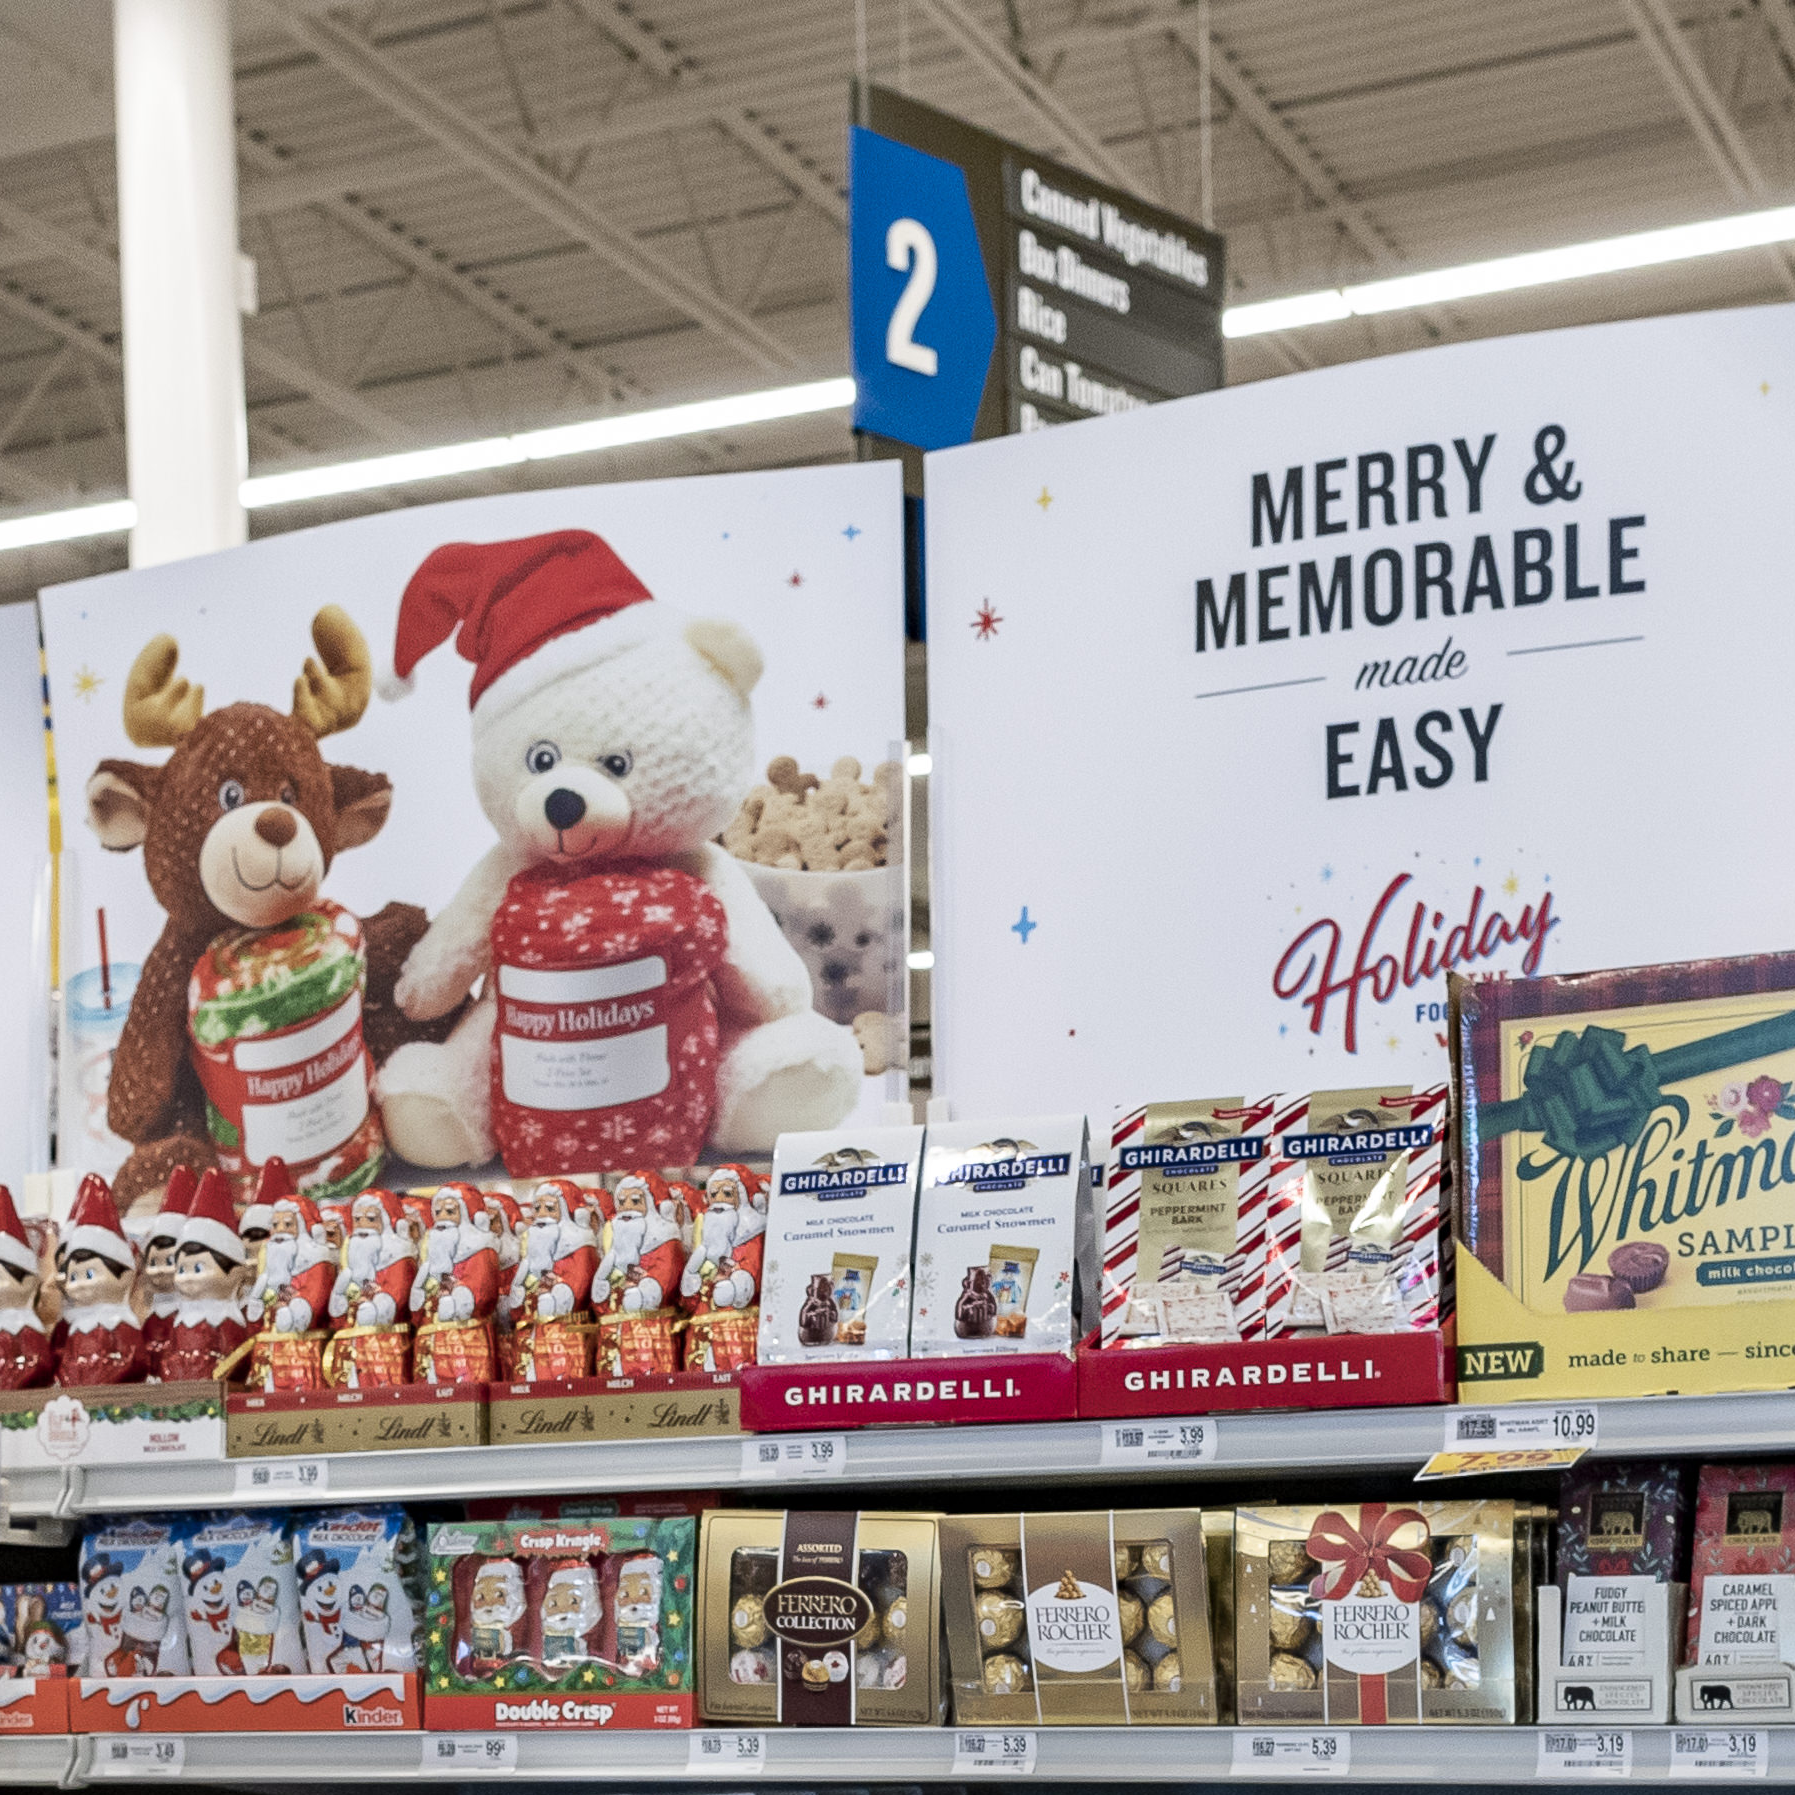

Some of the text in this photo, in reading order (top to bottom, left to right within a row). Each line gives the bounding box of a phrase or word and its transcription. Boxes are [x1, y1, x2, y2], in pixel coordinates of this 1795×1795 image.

[886, 218, 938, 377] 2
[1251, 424, 1582, 547] MERRY &
[1194, 515, 1646, 652] MEMORABLE
[1354, 637, 1469, 691] made
[1325, 703, 1504, 799] EASY
[1272, 873, 1559, 1053] Holiday
[506, 999, 655, 1037] Happy Holidays
[1124, 1138, 1260, 1167] GHIRARDELLI
[783, 1165, 908, 1193] GHIRARDELLI
[1151, 1178, 1228, 1196] SQUARES
[960, 1206, 1035, 1218] MILK CHOCOLATE
[1149, 1202, 1226, 1218] PEPPERMINT
[1171, 1214, 1204, 1226] BARK
[937, 1214, 1056, 1235] Caramel Snowmen
[1708, 1266, 1740, 1279] milk
[1463, 1349, 1533, 1374] NEW
[1568, 1349, 1626, 1367] made
[1651, 1345, 1711, 1362] share
[784, 1379, 1021, 1405] GHIRARDELLI
[250, 1421, 309, 1447] Lindt
[1553, 1413, 1595, 1436] 10.99
[1179, 1427, 1204, 1445] 3.99
[520, 1531, 603, 1550] Crisp Kringle
[795, 1543, 843, 1555] ASSORTED
[1595, 1587, 1628, 1599] FUDGY
[777, 1593, 857, 1617] FERRERO
[1570, 1601, 1645, 1614] PEANUT BUTTE
[775, 1615, 857, 1634] COLLECTION
[1035, 1605, 1111, 1627] FERRERO
[1602, 1616, 1626, 1628] MILK
[1036, 1623, 1113, 1641] ROCHER
[1579, 1630, 1637, 1642] CHOCOLATE
[495, 1702, 613, 1725] Double Crisp
[738, 1736, 760, 1755] 5.39
[1003, 1736, 1028, 1755] 5.39
[1597, 1736, 1623, 1752] 3.19
